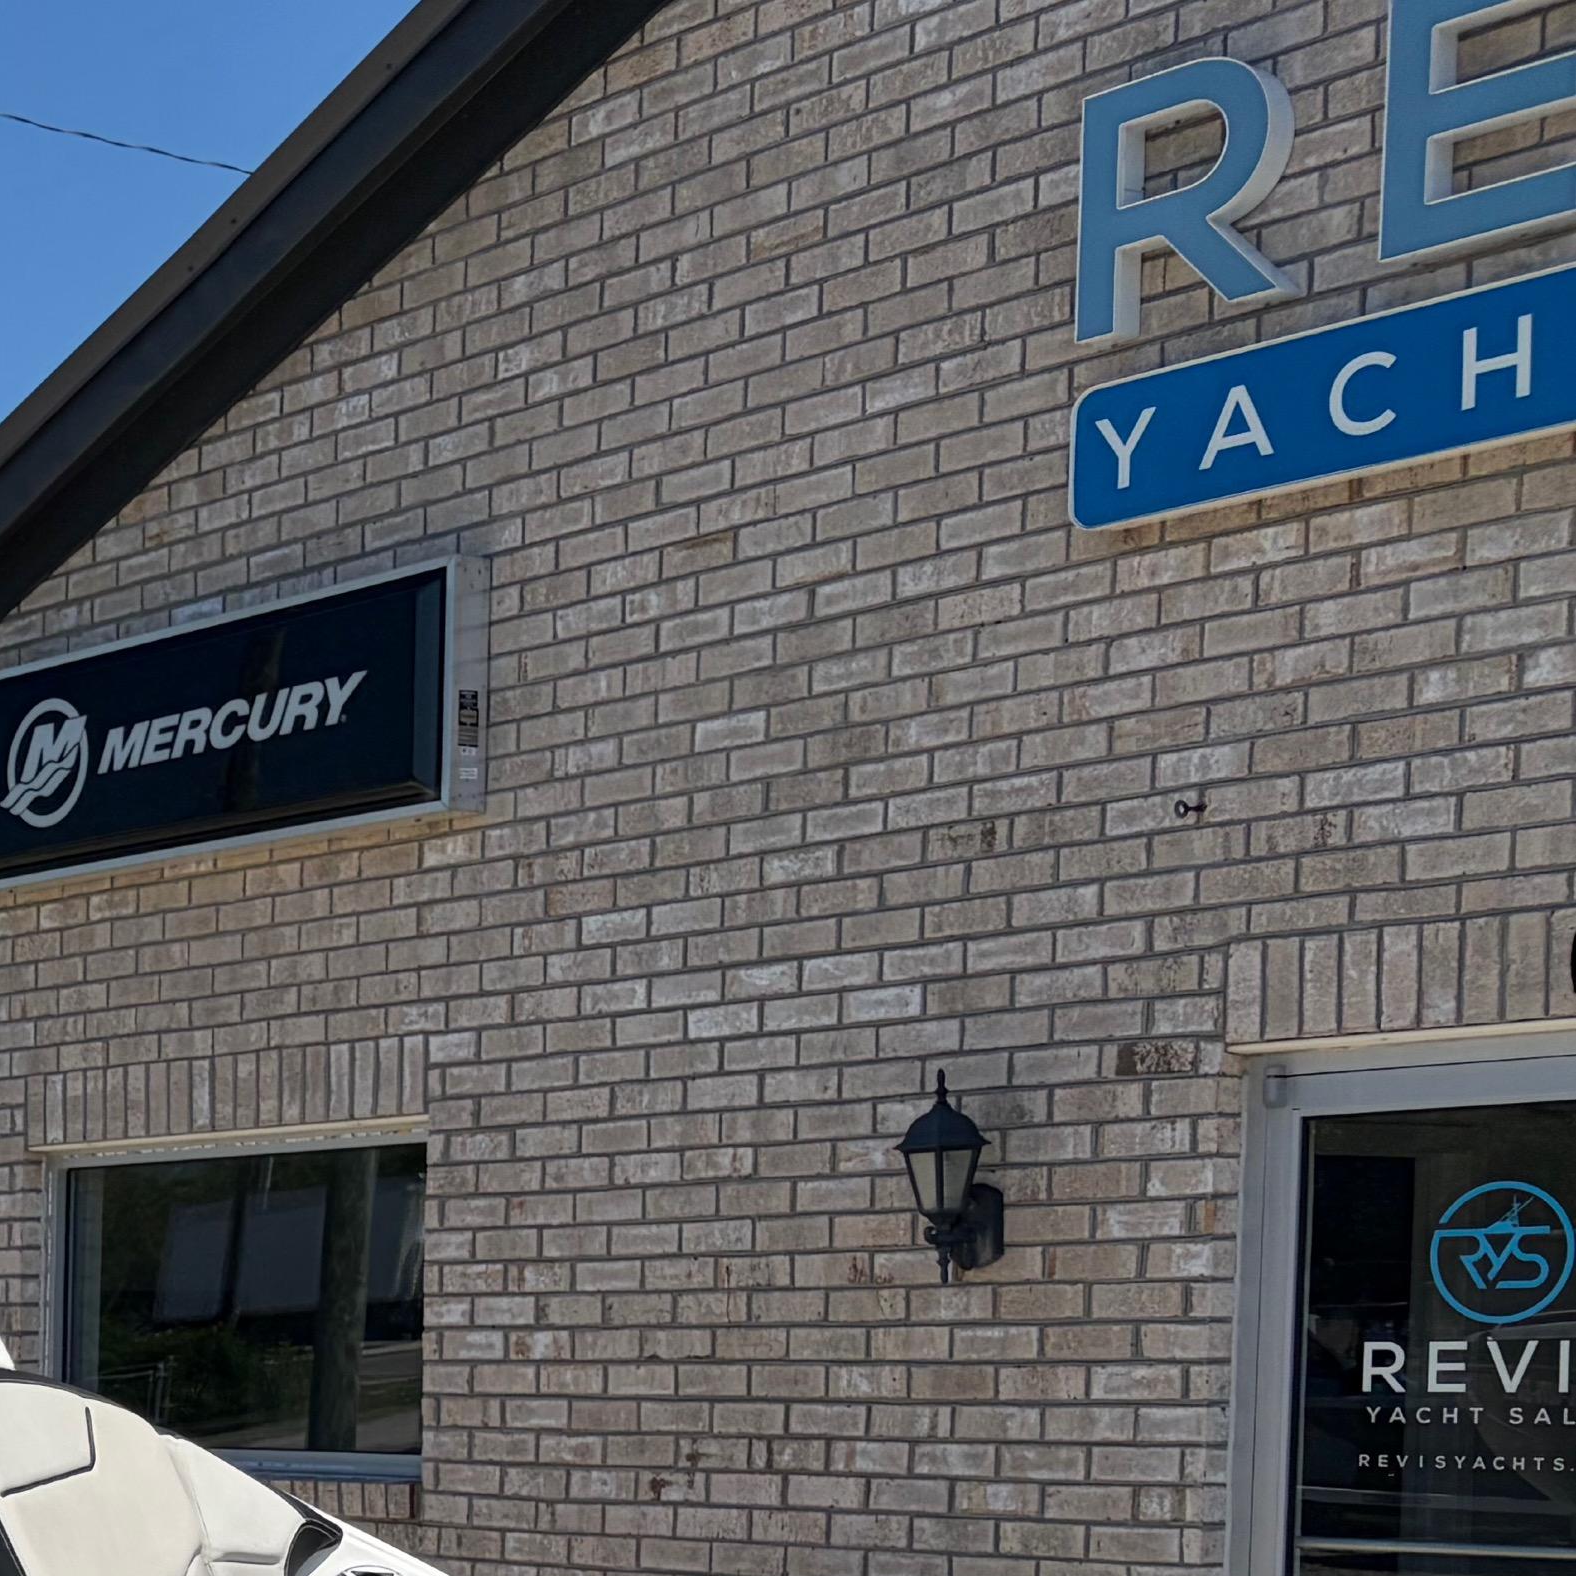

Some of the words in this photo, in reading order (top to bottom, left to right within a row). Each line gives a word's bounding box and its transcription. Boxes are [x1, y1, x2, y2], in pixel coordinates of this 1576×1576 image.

[1095, 313, 1533, 490] YACH
[97, 670, 367, 775] MERCURY
[1362, 1337, 1570, 1394] REVI
[1366, 1406, 1484, 1425] YACHT
[1509, 1406, 1576, 1426] SAL
